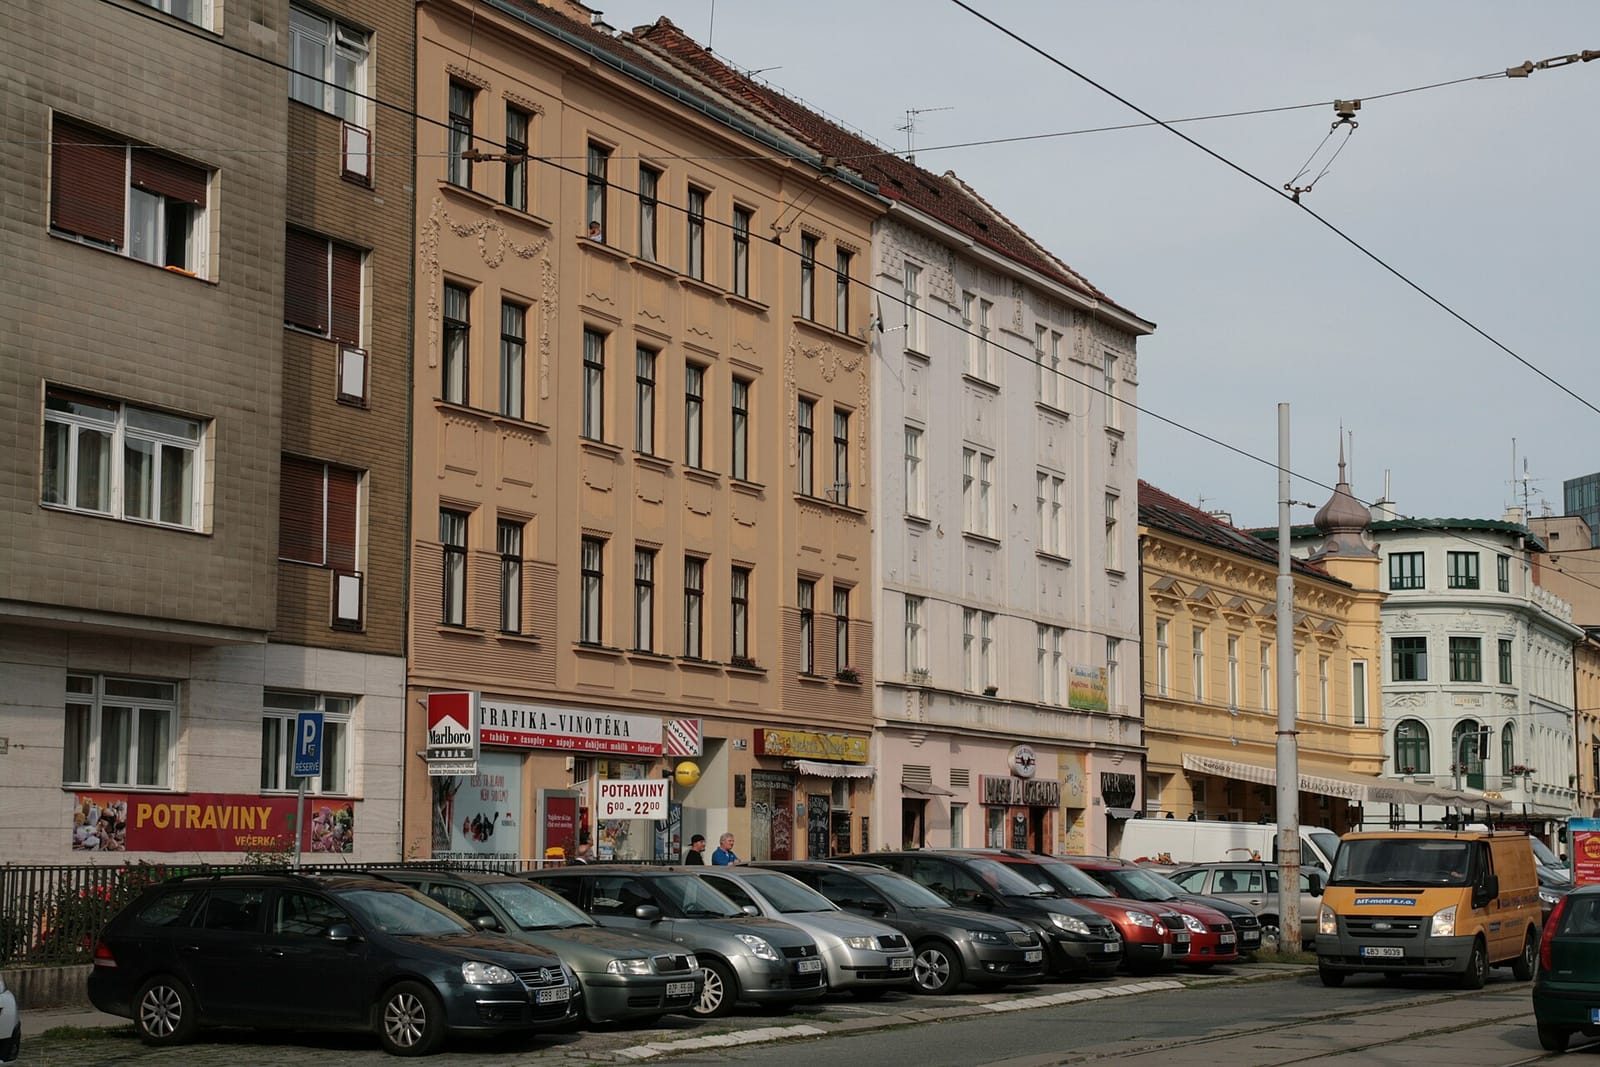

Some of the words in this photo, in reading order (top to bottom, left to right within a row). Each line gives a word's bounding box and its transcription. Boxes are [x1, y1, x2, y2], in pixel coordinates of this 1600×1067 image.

[429, 725, 471, 745] Marlboro
[480, 706, 630, 737] TRAFIKA-VINOTÉKA
[302, 719, 316, 756] P
[601, 783, 664, 798] POTRAVINY
[136, 803, 273, 830] POTRAVINY
